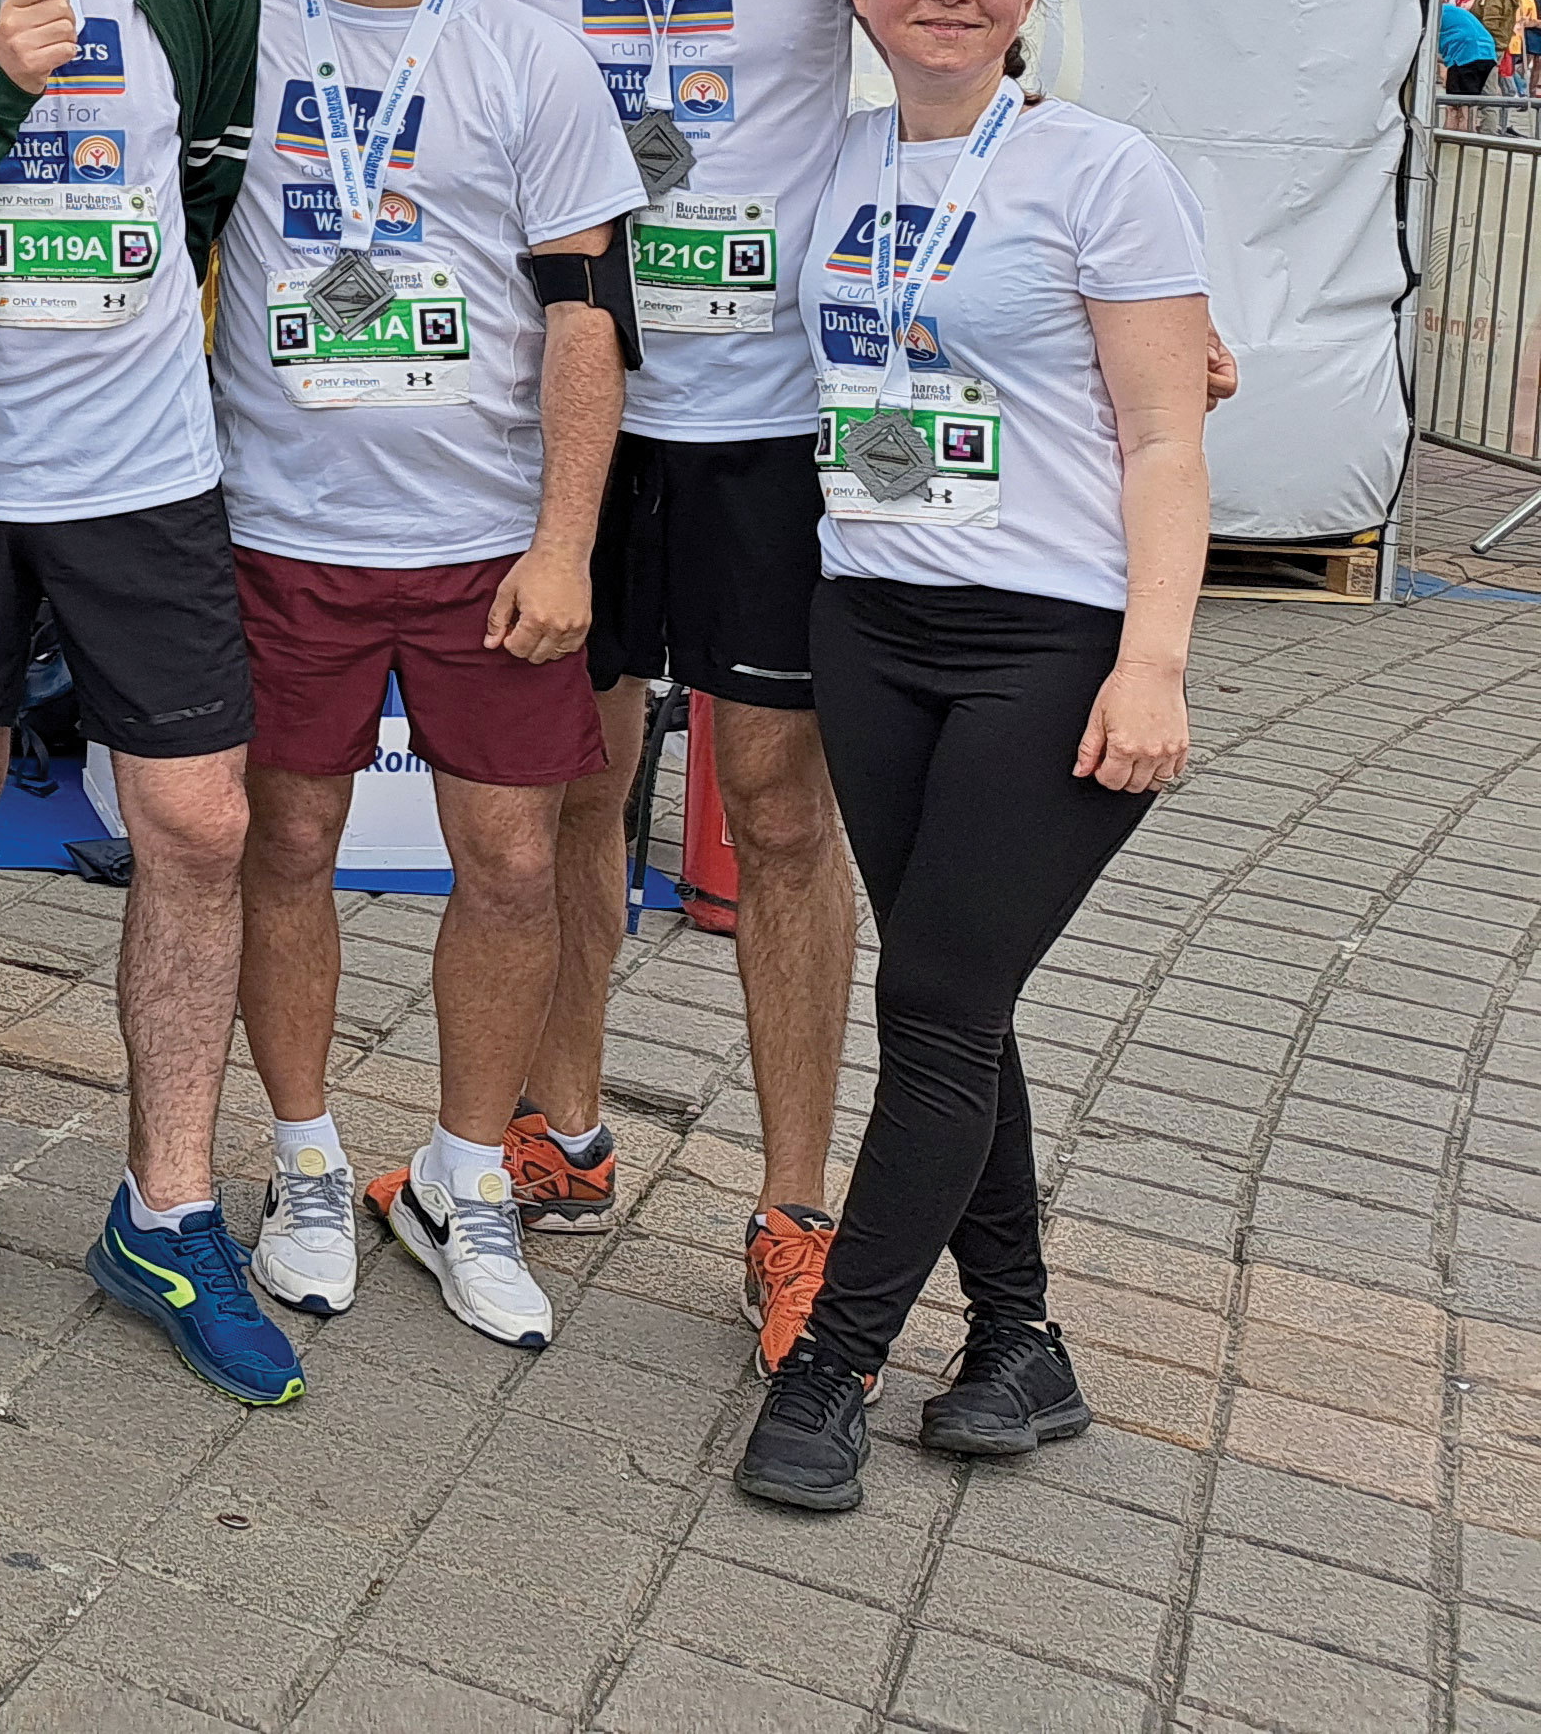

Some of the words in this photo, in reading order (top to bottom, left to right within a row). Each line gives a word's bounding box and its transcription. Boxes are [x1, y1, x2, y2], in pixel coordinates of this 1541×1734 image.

[611, 42, 652, 56] run
[673, 40, 709, 58] for
[396, 69, 411, 94] OMV
[68, 104, 101, 123] for
[322, 86, 342, 139] Bucharest
[381, 93, 403, 126] Petrom
[8, 137, 65, 157] nited
[21, 159, 66, 184] Way
[17, 195, 53, 205] Petrom
[66, 192, 121, 204] Bucharest
[286, 189, 342, 210] Unite
[676, 201, 737, 215] Bucharest
[696, 213, 737, 221] MARATHON
[314, 212, 343, 232] Wa
[938, 214, 952, 238] OMV
[19, 235, 107, 262] 3119A
[916, 239, 940, 273] Petrom
[837, 283, 875, 300] run
[13, 298, 38, 307] OMV
[41, 297, 77, 307] Petrom
[644, 300, 682, 312] Petrom
[823, 310, 889, 336] United
[850, 335, 888, 364] Way
[315, 378, 340, 387] OMV
[343, 377, 380, 387] Petrom
[841, 383, 878, 393] Petrom
[912, 382, 951, 394] harest
[833, 487, 854, 497] OMV
